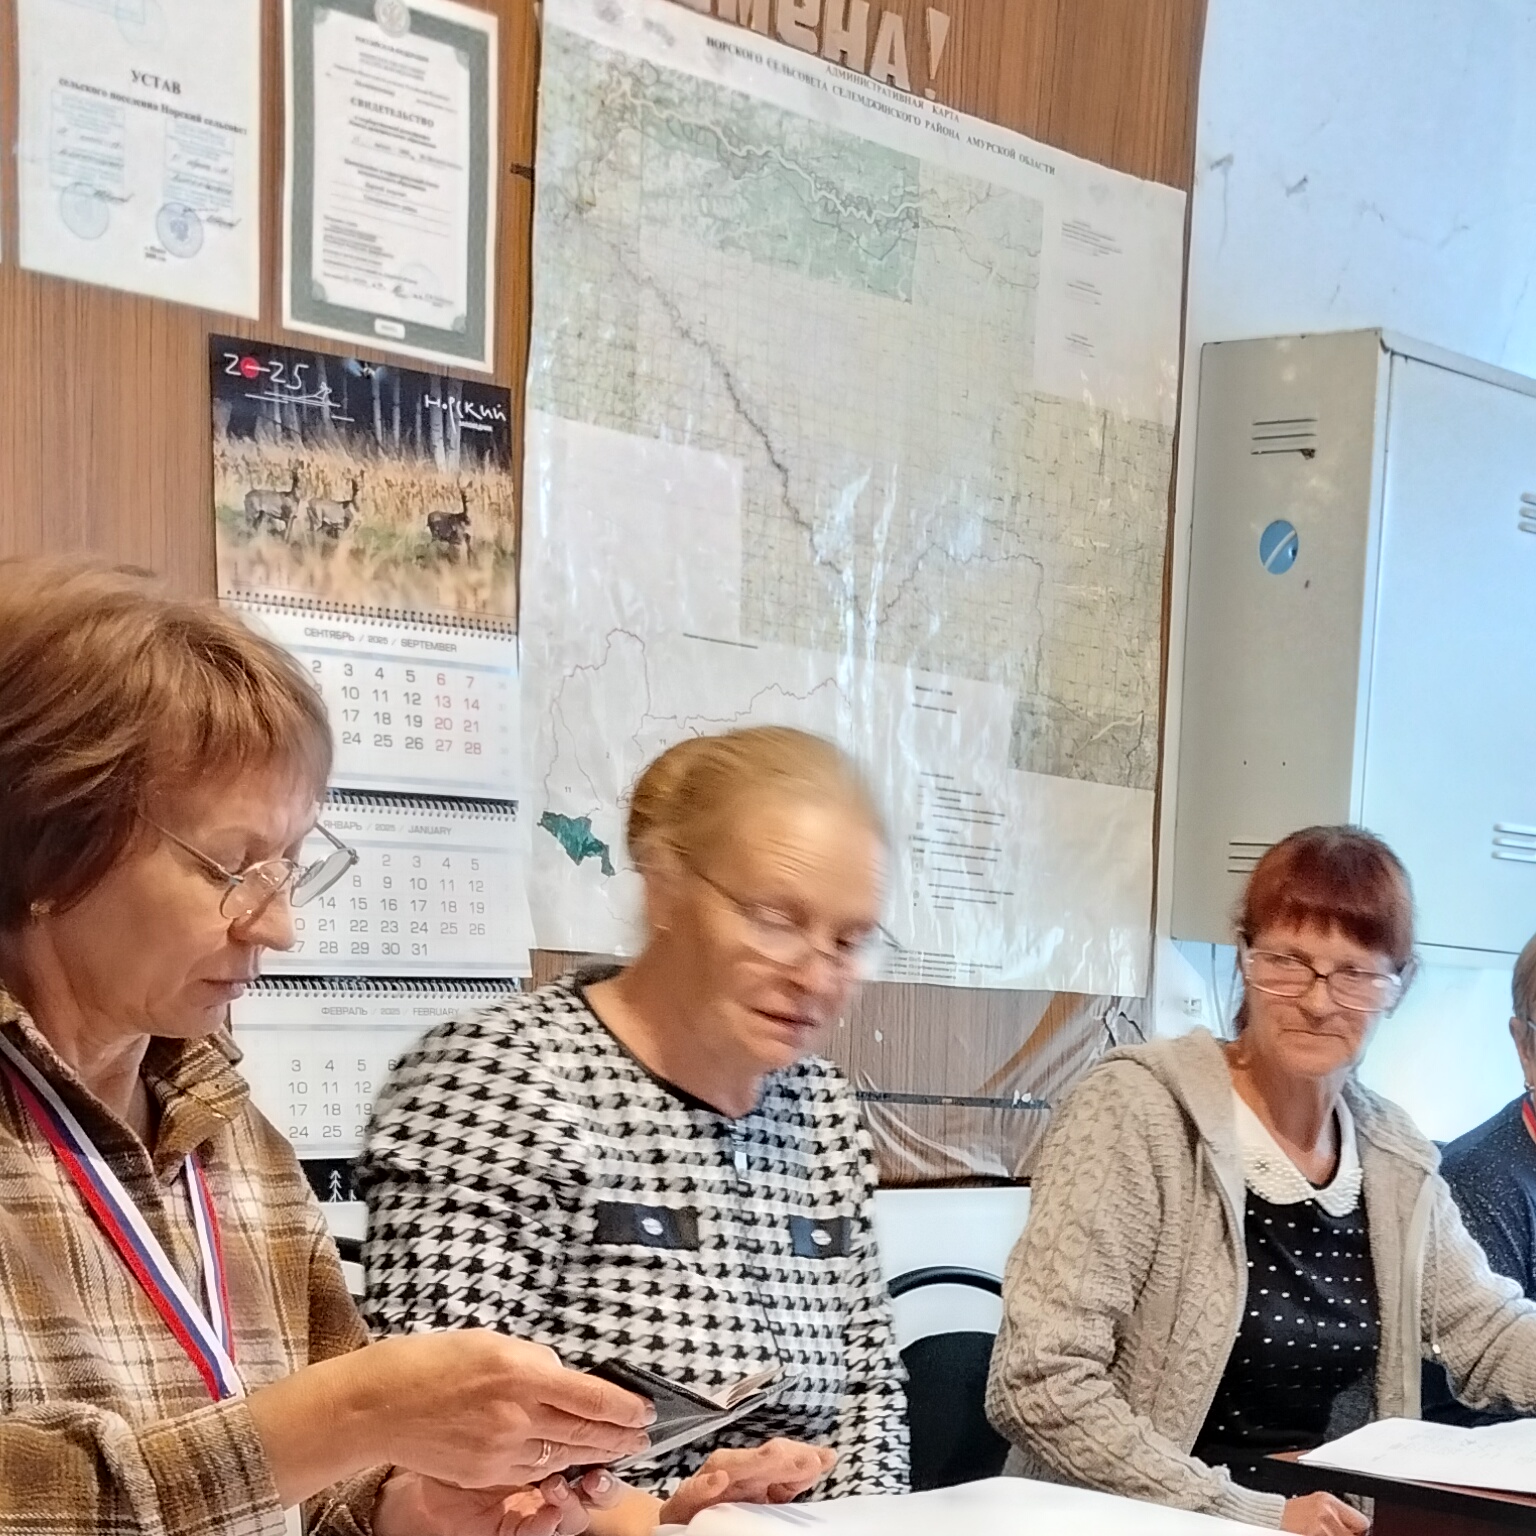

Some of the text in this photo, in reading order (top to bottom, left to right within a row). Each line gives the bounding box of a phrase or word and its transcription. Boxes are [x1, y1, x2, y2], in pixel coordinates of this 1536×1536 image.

[131, 69, 181, 95] УСТАВ
[825, 65, 960, 123] АДМИНИСТРАТИВНАЯ КАРТА
[350, 97, 434, 128] СВИДЕТЕЛЬСТВО
[706, 36, 763, 66] НОРСКОГО
[766, 57, 828, 92] СЕЛЬСОВЕТА
[925, 120, 960, 141] РАЙОНА
[966, 135, 1016, 160] АМУРСКОЙ
[1019, 153, 1055, 175] ОБЛАСТИ
[304, 627, 355, 642] СЕНТЯБРЬ
[367, 635, 389, 645] 2025
[400, 638, 457, 653] SEPTEMBER
[312, 660, 475, 689] 2 3 4 5 6 7
[341, 686, 360, 700] 10
[372, 689, 389, 702] 11
[403, 692, 421, 705] 12
[434, 695, 452, 708] 13
[464, 698, 480, 711] 14
[342, 709, 479, 732] 17 18 19 20 21
[342, 731, 482, 755] 24 25 26 27 28
[323, 820, 362, 831] ЯНВАРЬ
[408, 825, 453, 836] JANUARY
[382, 854, 479, 871] 2 3 4 5
[352, 875, 484, 893] 8 9 10 11 12
[318, 896, 485, 914] 14 15 16 17 18 19
[318, 918, 336, 931] 21
[350, 919, 368, 932] 22
[380, 920, 399, 933] 23
[410, 921, 429, 934] 24
[440, 922, 458, 935] 25
[469, 923, 486, 935] 26
[319, 941, 339, 954] 28
[351, 941, 369, 954] 29
[381, 942, 400, 955] 30
[411, 943, 428, 956] 31
[321, 1007, 368, 1016] ФЕВРАЛЬ
[291, 1059, 301, 1072] 3
[325, 1059, 334, 1072] 4
[357, 1059, 366, 1072] 5
[288, 1081, 372, 1094] 10 11 12
[289, 1103, 372, 1116] 17 18 19
[289, 1126, 309, 1139] 24
[322, 1125, 342, 1138] 25
